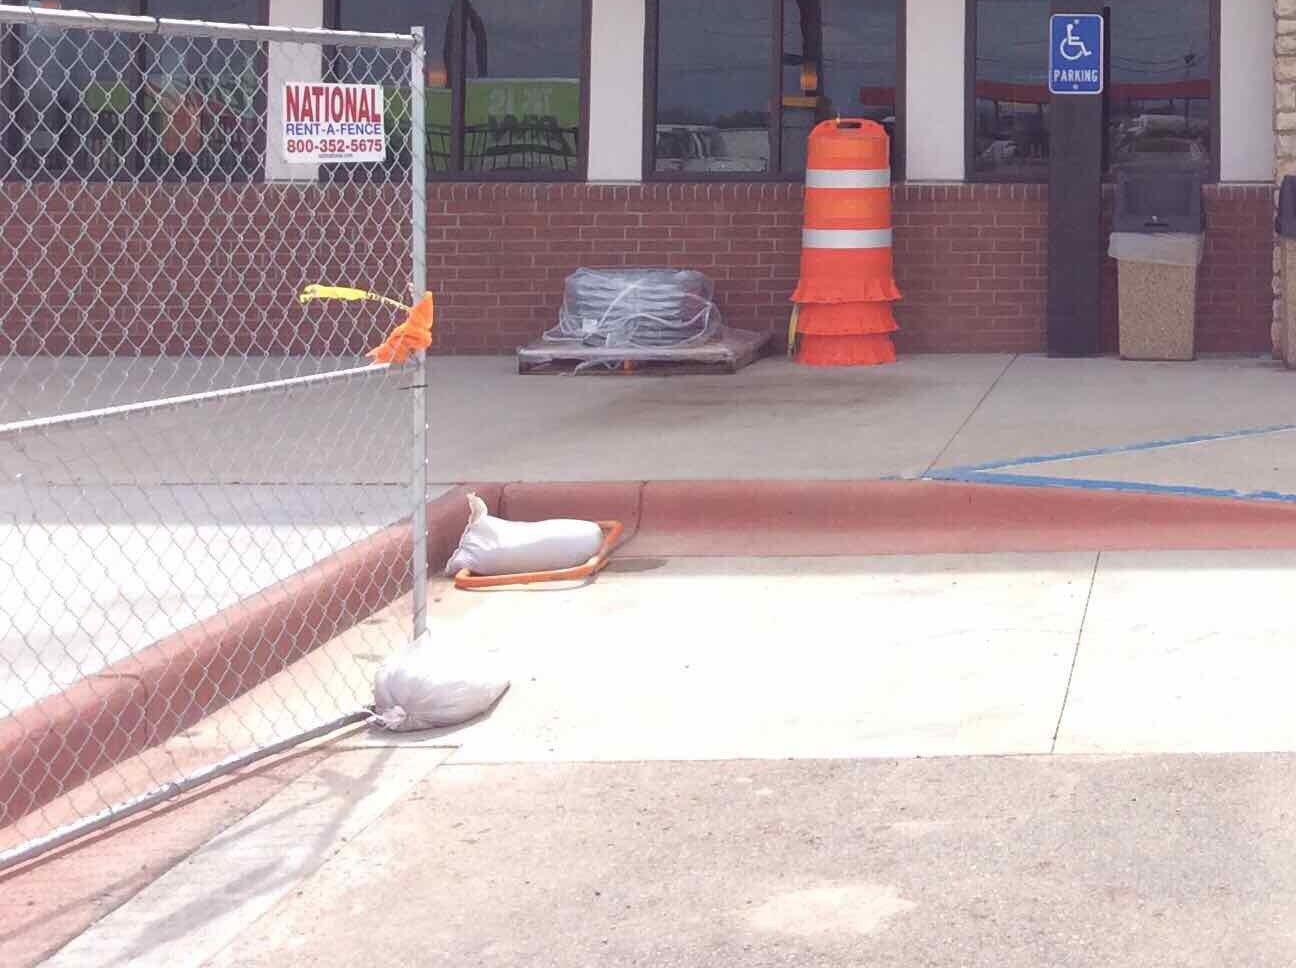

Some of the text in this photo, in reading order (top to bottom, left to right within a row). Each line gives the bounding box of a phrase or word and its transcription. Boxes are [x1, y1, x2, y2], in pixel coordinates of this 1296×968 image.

[1053, 69, 1098, 82] PARKING
[286, 85, 381, 123] NATIONAL
[286, 123, 381, 136] RENT-A-FENCE
[287, 139, 382, 153] 800-352-5675
